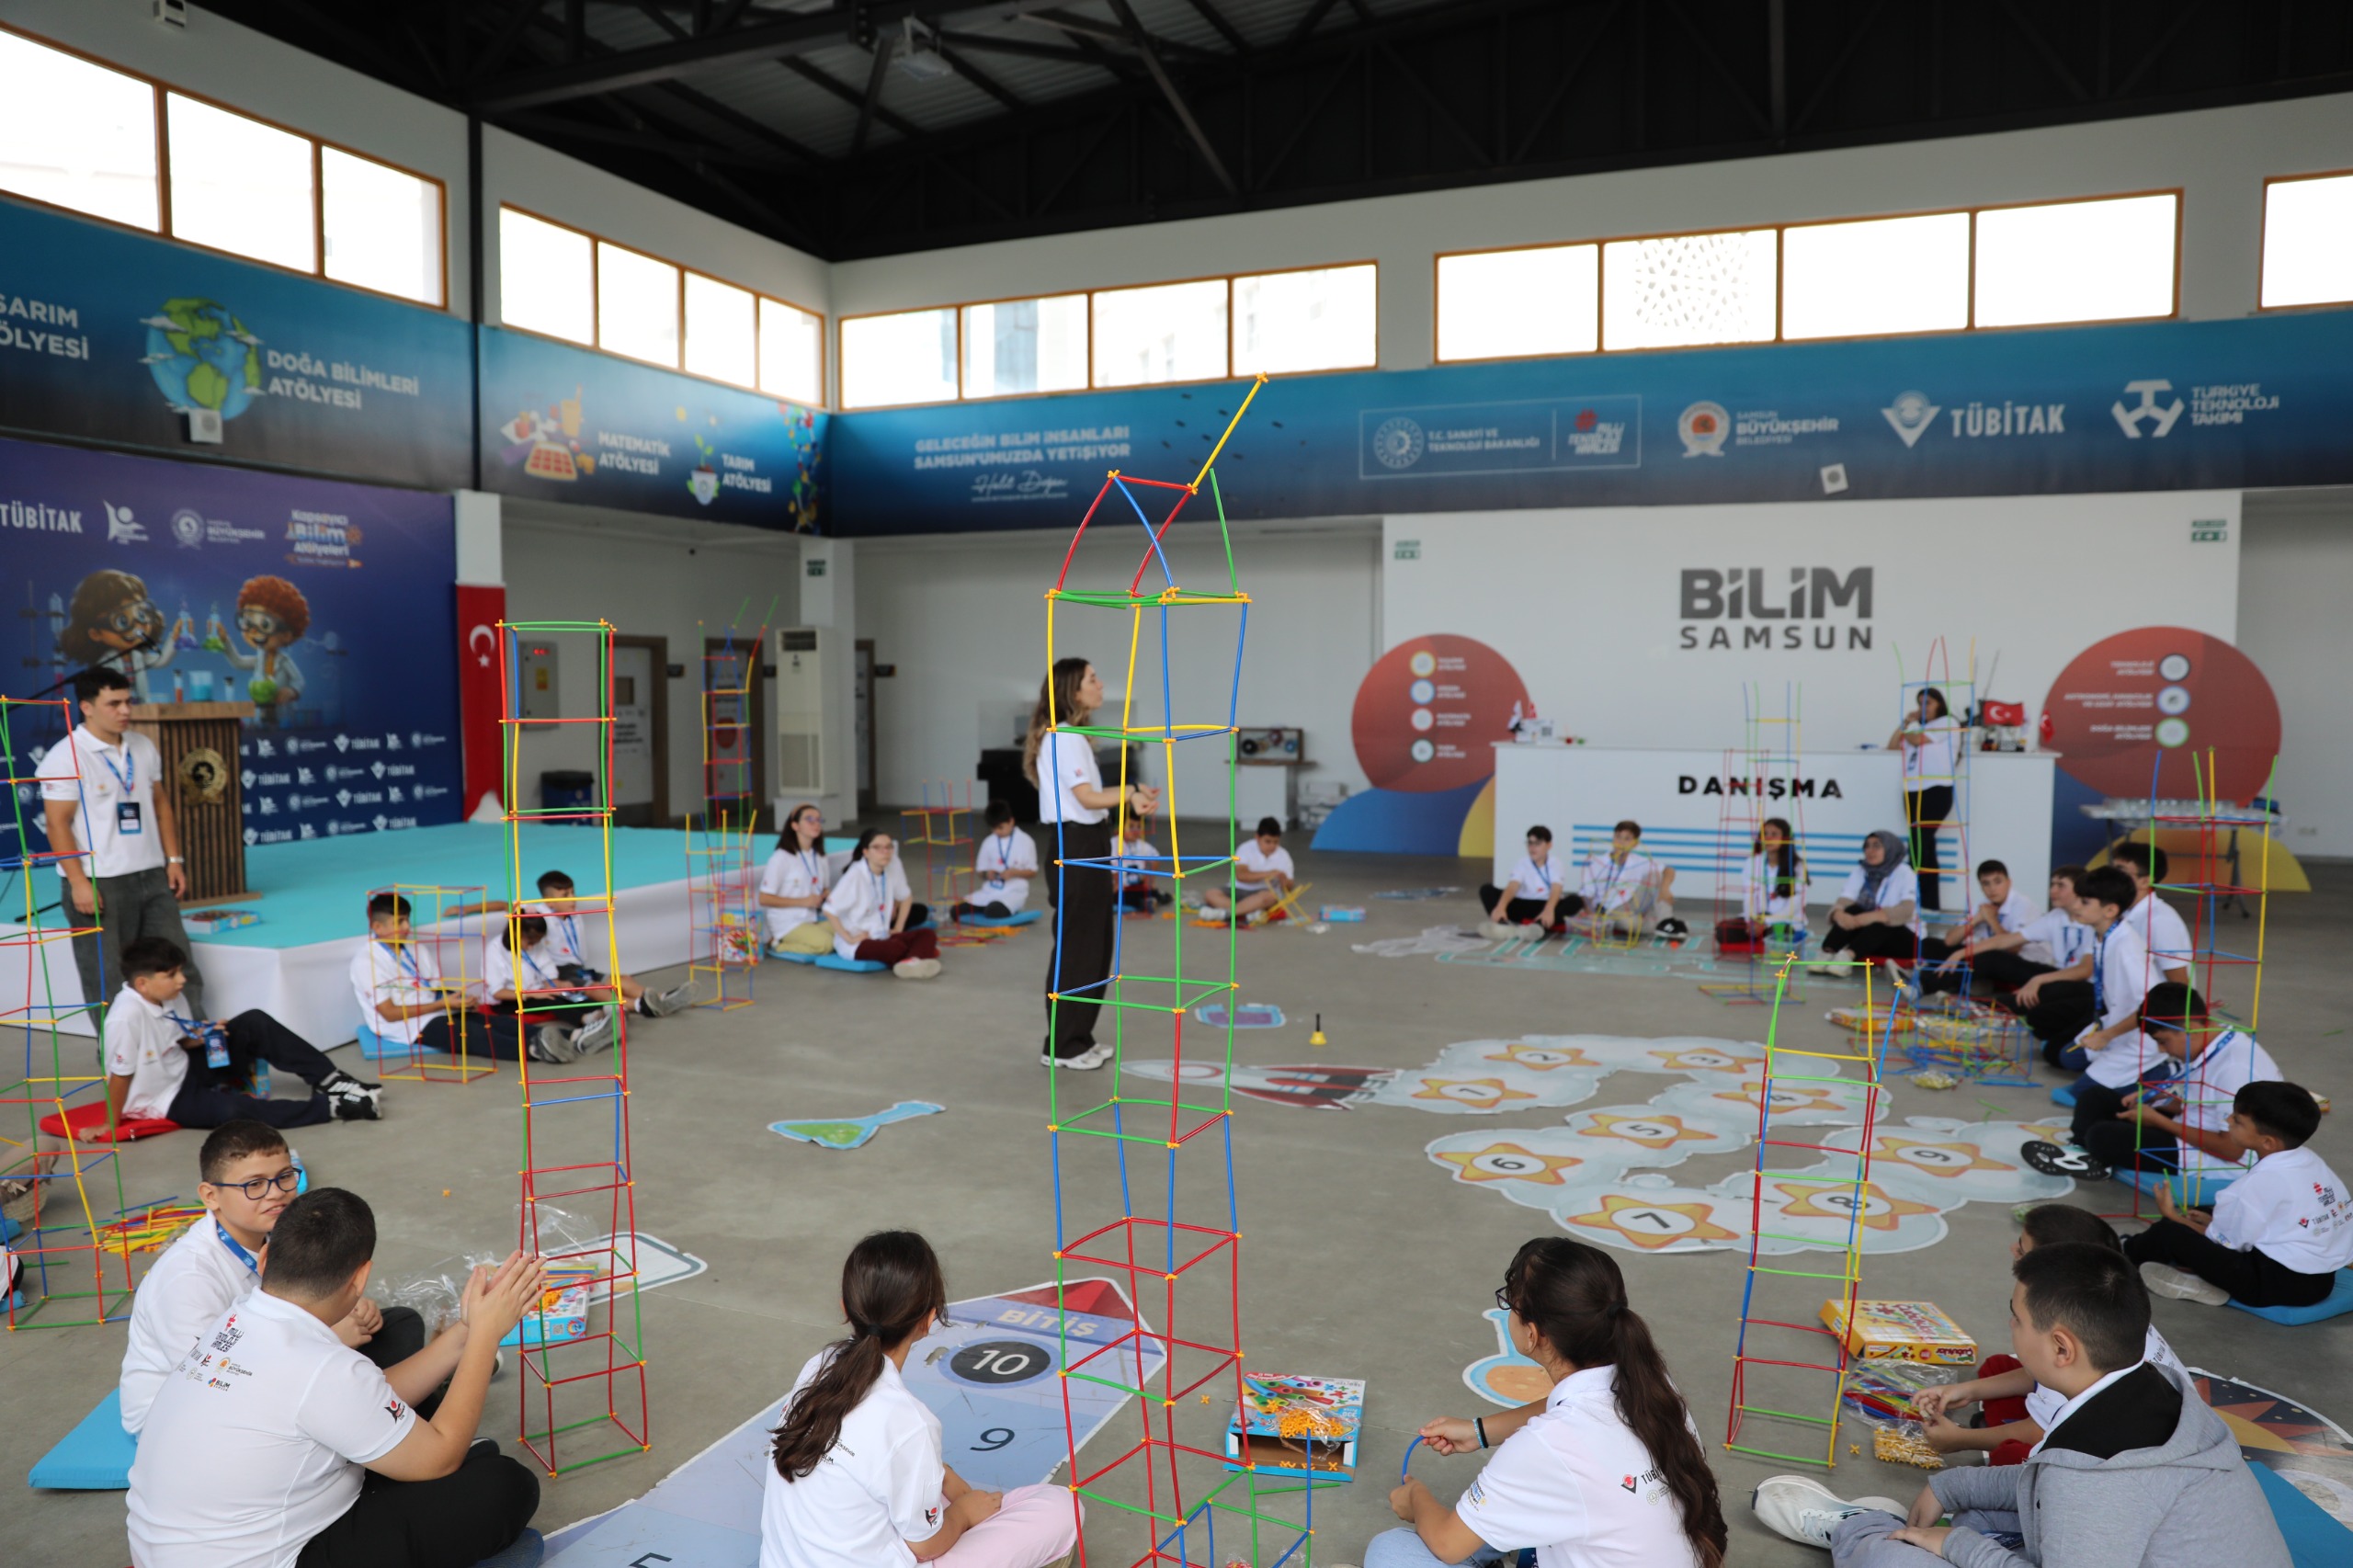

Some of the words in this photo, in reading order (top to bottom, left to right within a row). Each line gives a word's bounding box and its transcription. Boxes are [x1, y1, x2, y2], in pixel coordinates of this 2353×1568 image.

[267, 349, 327, 379] DOĞA
[331, 360, 420, 396] BİLİMLERİ
[268, 376, 362, 410] ATÖLYESİ
[2191, 382, 2260, 398] TÜRKİYE
[2190, 394, 2279, 412] TEKNOLOJİ
[1736, 416, 1839, 435] BÜYÜKŞEHİR
[1950, 401, 2065, 437] TÜBİTAK
[2190, 411, 2243, 426] TAKIMI
[598, 431, 671, 458] MATEMATİK
[915, 433, 995, 452] GELECEĞİN
[1000, 431, 1040, 448] BİLİM
[1044, 426, 1130, 445] İNSANLARI
[598, 451, 659, 476] ATÖLYESİ
[722, 453, 755, 472] TARIM
[1047, 444, 1131, 461] YETİŞİYOR
[722, 472, 772, 493] ATÖLYESİ
[0, 500, 83, 533] TÜBİTAK
[1680, 566, 1873, 619] BİLİM
[1680, 626, 1871, 650] SAMSUN
[1678, 776, 1843, 801] DANIŞMA
[1628, 1124, 1662, 1136] 5
[1631, 1211, 1671, 1229] 7
[972, 1349, 1030, 1375] 10
[969, 1427, 1015, 1451] 9
